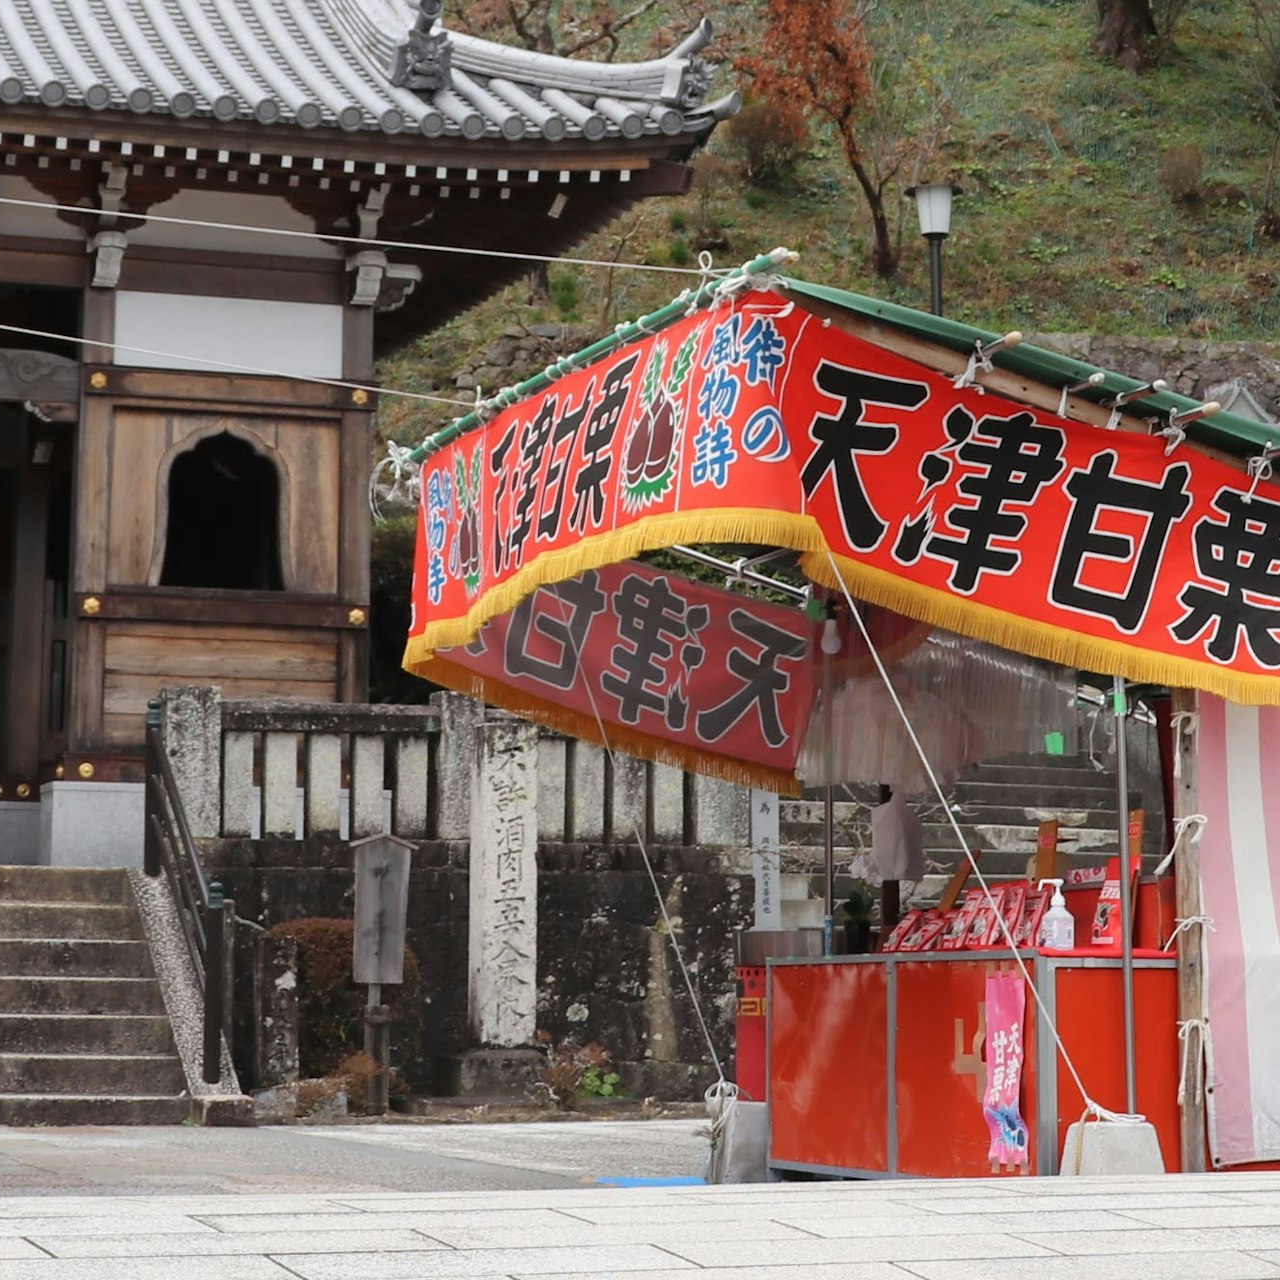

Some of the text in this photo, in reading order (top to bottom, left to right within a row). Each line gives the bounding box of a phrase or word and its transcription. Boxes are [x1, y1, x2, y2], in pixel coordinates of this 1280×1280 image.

[490, 349, 642, 578] 天津甘栗
[691, 312, 743, 489] 風物詩
[1005, 1022, 1022, 1096] 天津
